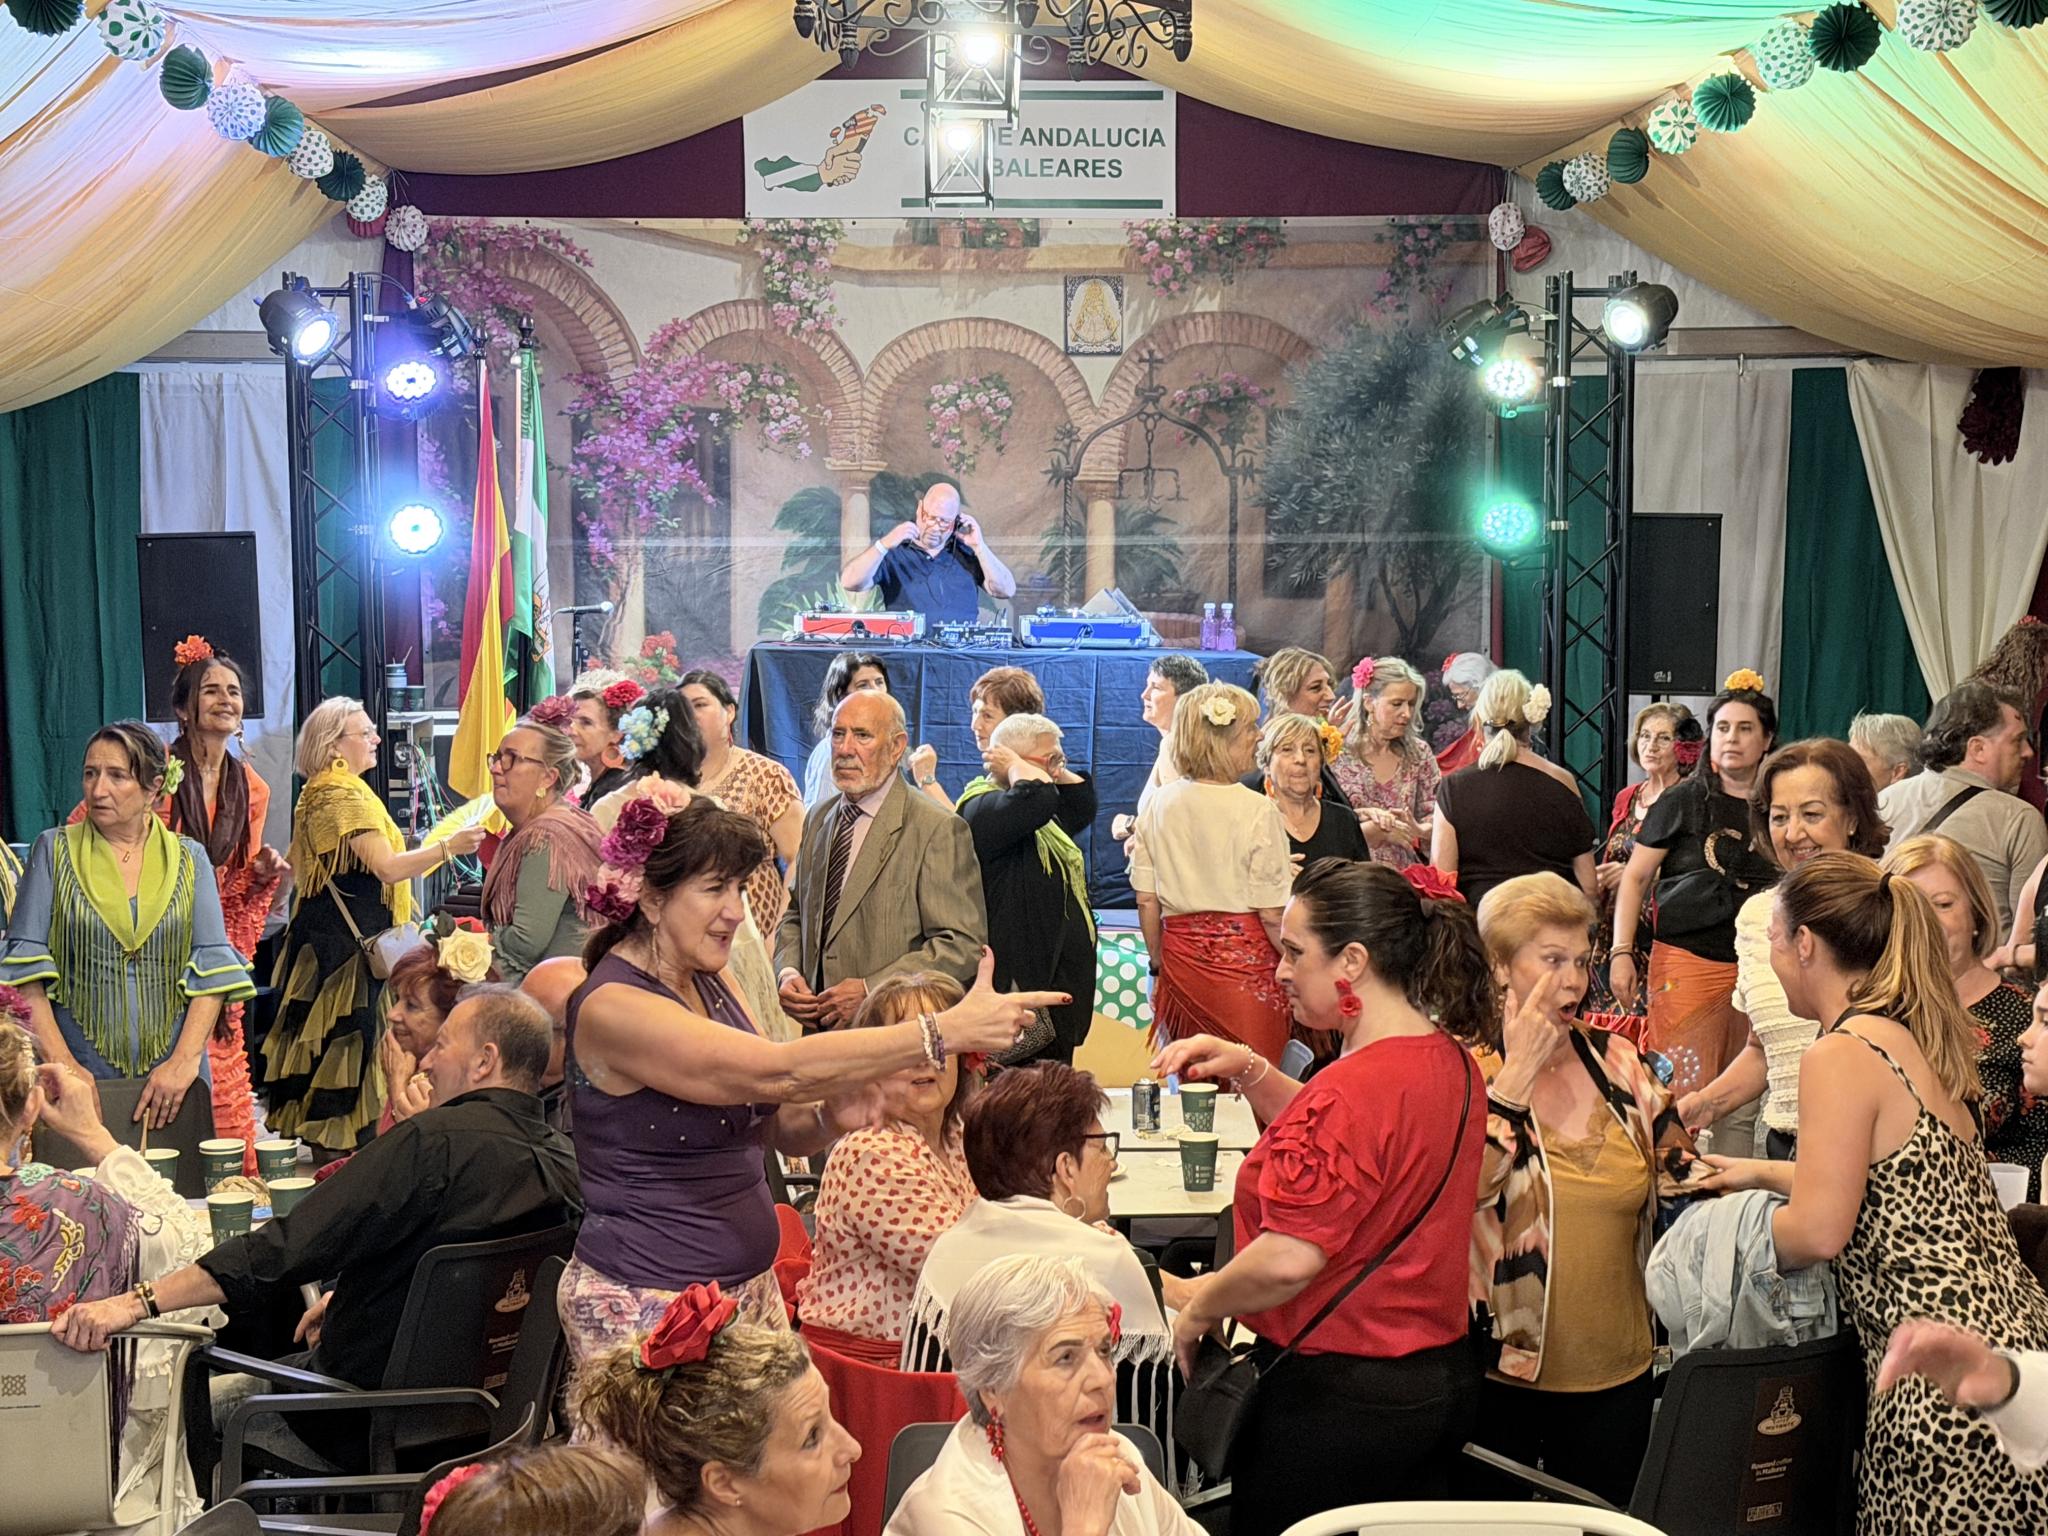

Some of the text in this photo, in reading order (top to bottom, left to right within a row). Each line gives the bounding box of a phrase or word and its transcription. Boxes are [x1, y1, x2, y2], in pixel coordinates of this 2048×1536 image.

[991, 127, 1166, 147] E ANDALUCIA
[993, 158, 1123, 178] BALEARES
